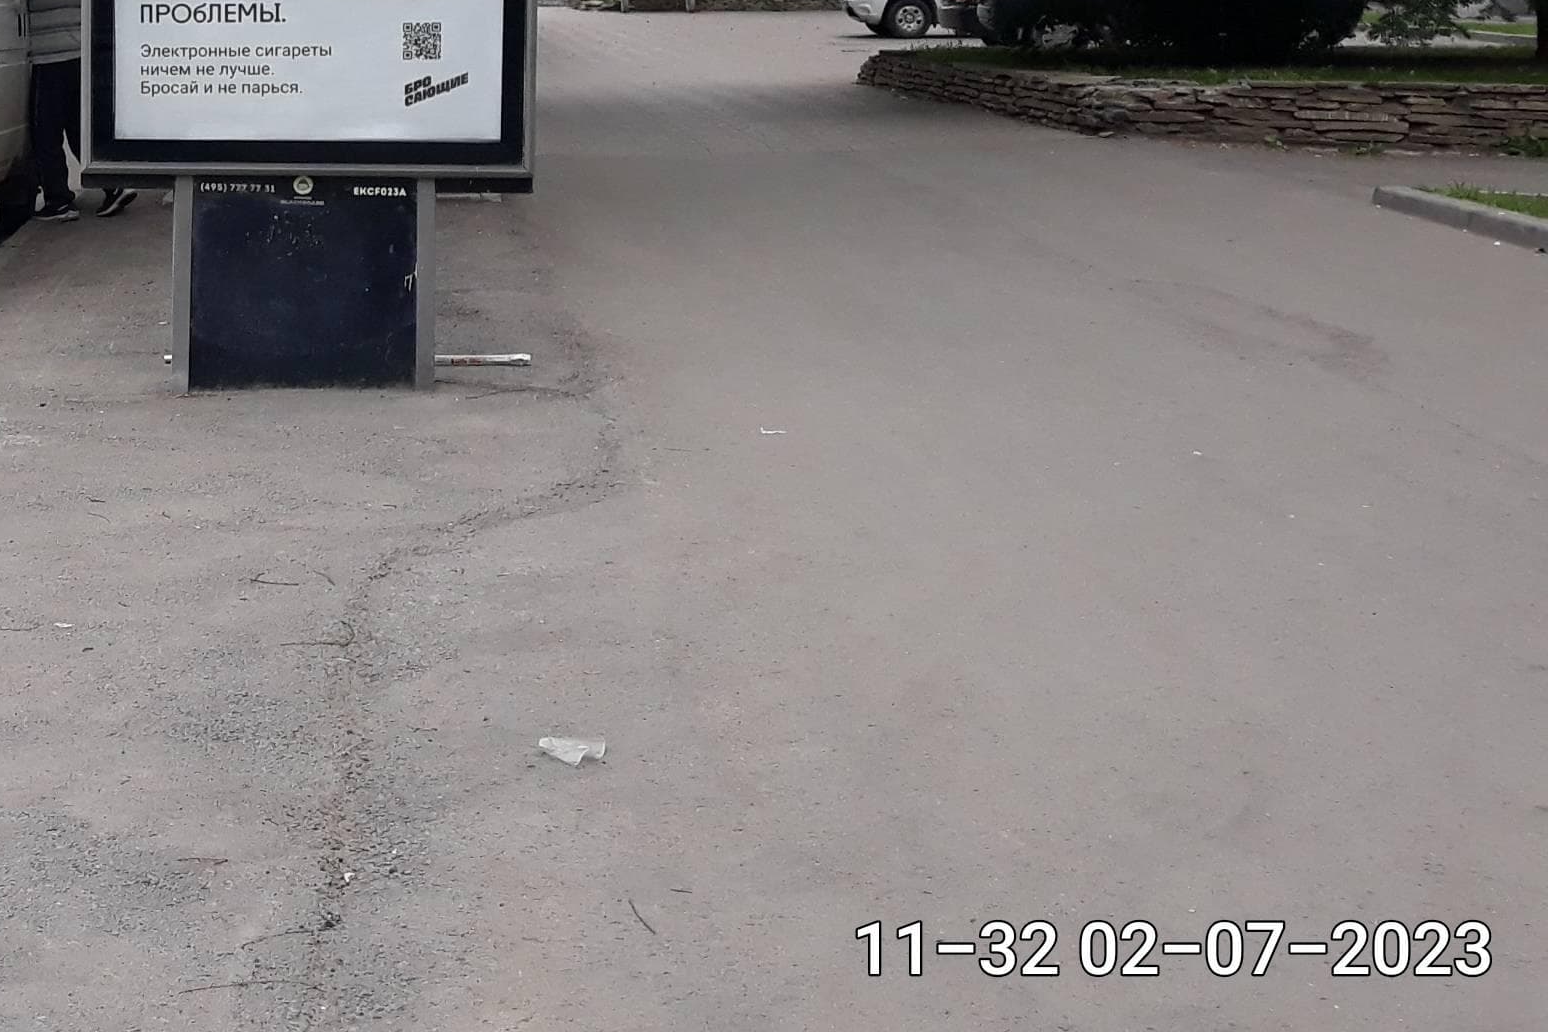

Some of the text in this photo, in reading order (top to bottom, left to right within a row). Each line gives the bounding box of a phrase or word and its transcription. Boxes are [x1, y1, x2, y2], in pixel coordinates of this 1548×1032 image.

[140, 43, 332, 60] Электронные сигареты
[140, 65, 275, 79] ничем не лучше.
[140, 80, 303, 97] Бросай и не парься.
[404, 75, 432, 96] БРО
[404, 72, 469, 107] САЮЩИЕ
